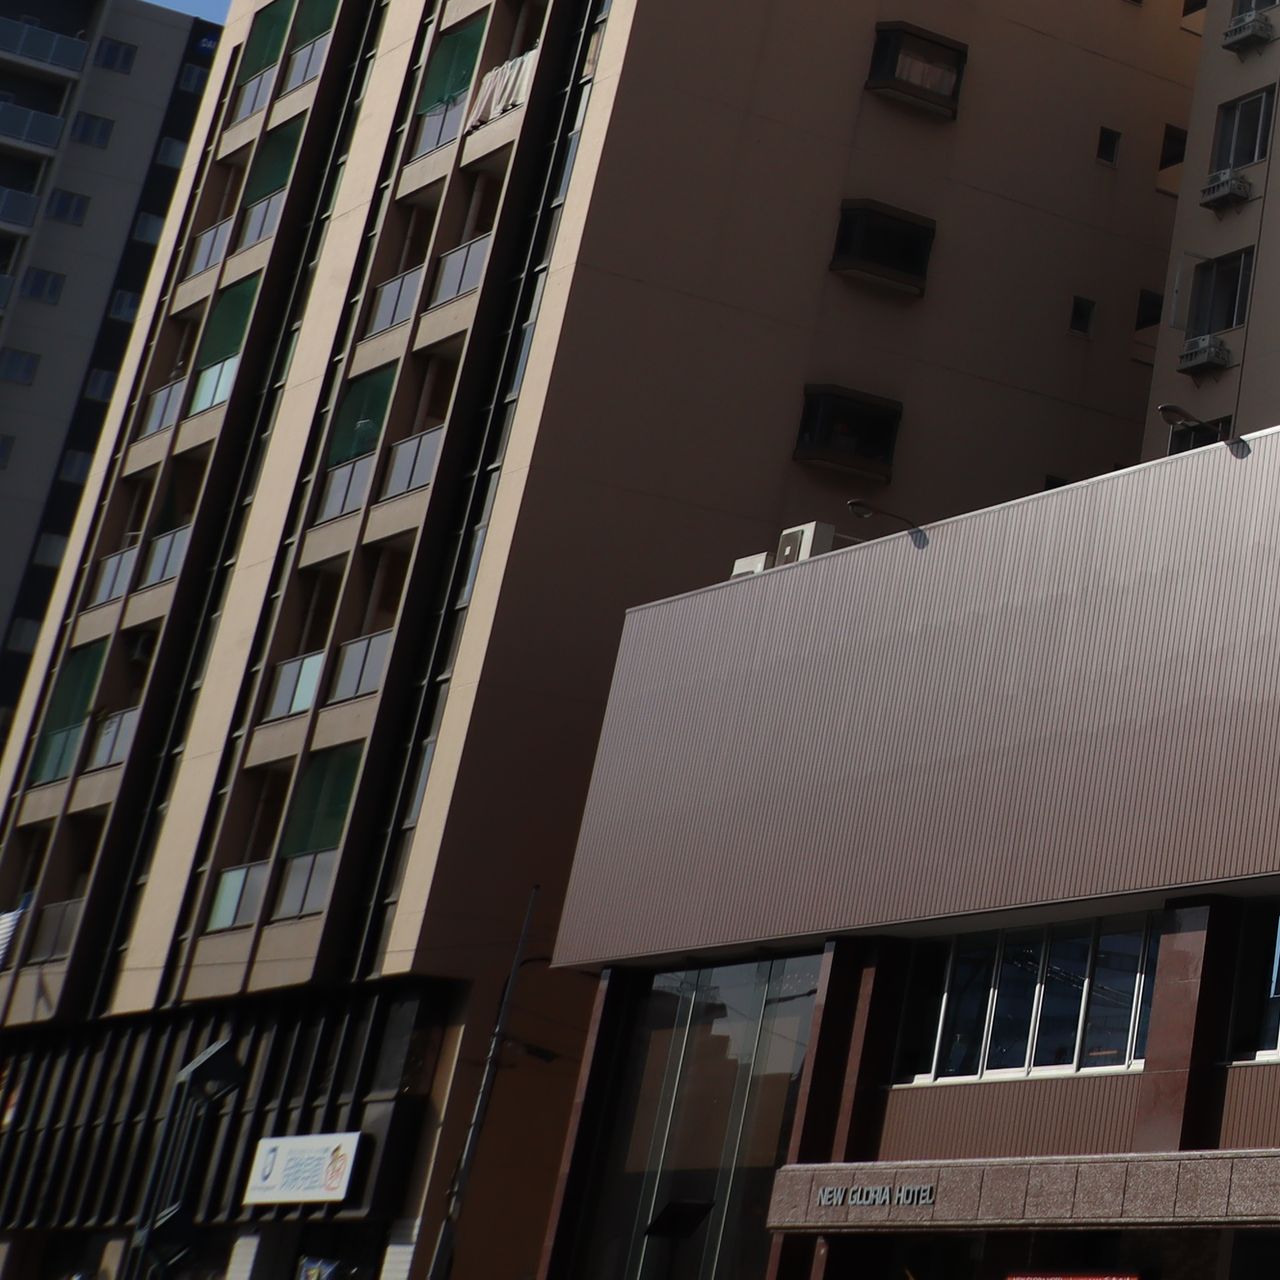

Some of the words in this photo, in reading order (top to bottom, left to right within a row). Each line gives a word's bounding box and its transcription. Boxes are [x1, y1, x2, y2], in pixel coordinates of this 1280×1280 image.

[817, 1186, 847, 1206] NEW
[848, 1185, 893, 1206] GLORIA
[894, 1185, 936, 1206] HOTEL
